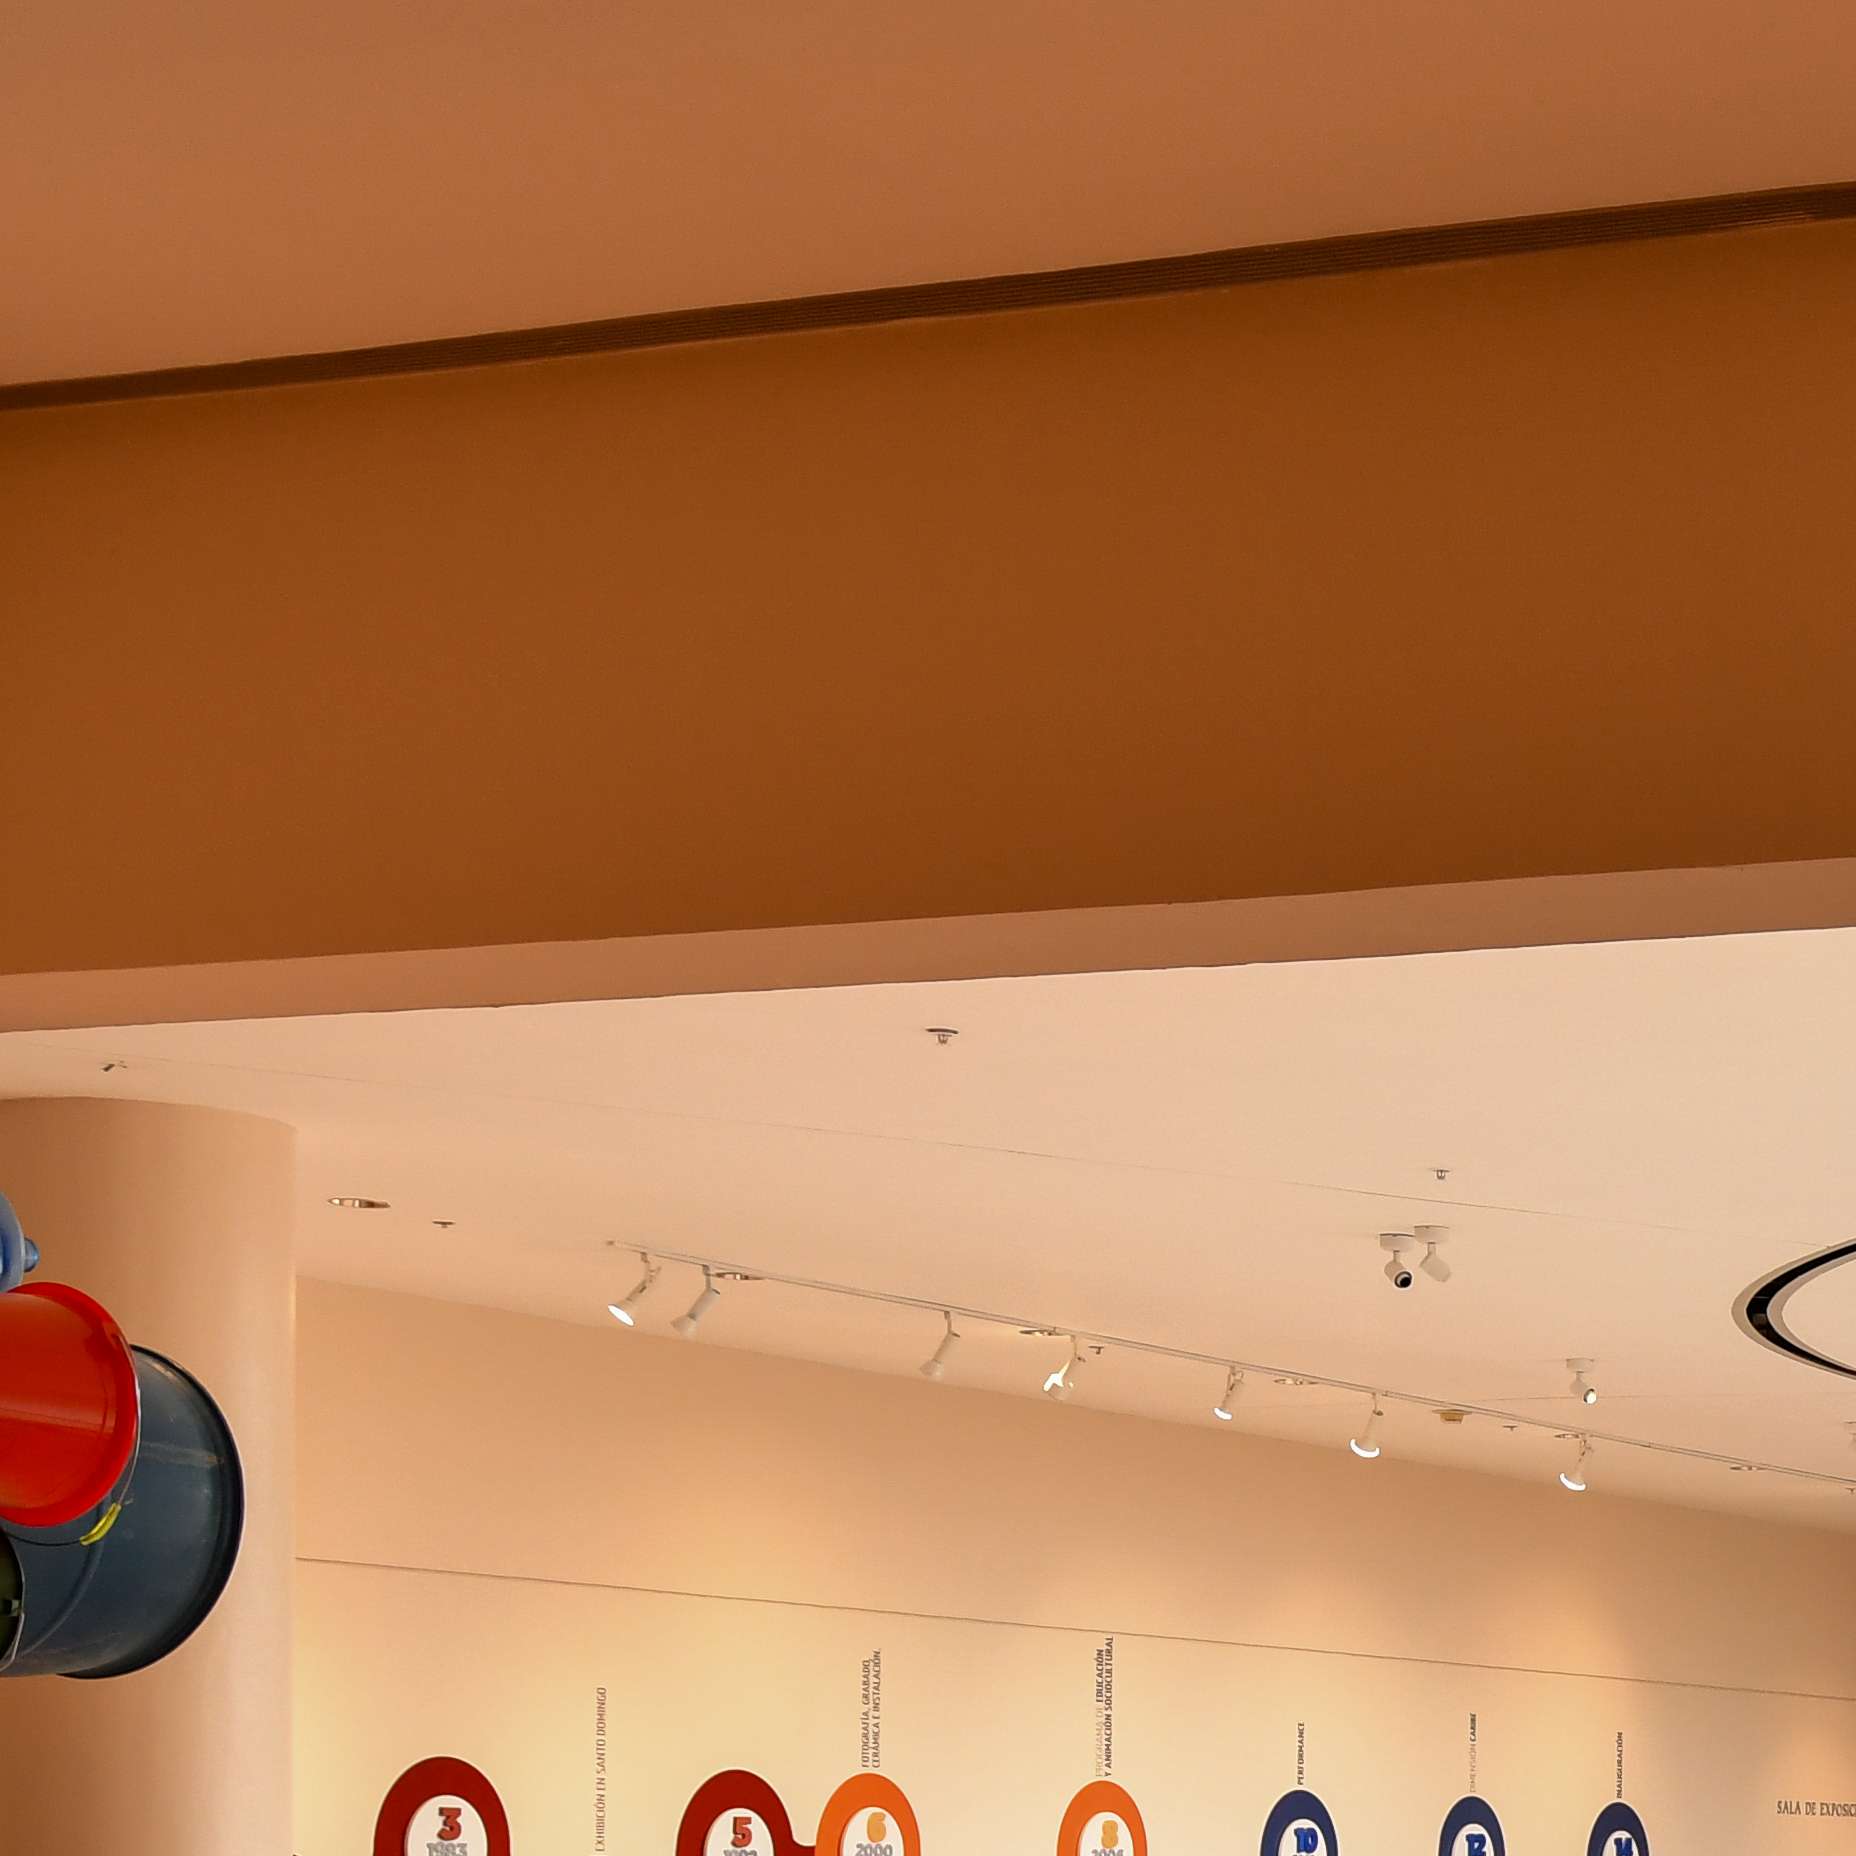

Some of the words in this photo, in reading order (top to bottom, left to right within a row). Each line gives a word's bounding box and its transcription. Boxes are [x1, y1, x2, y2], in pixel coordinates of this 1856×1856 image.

[1777, 1800, 1801, 1816] SALA
[1805, 1801, 1817, 1816] DE
[437, 1807, 462, 1841] 3
[731, 1816, 752, 1848] 5
[867, 1812, 886, 1843] 6
[1101, 1820, 1119, 1849] 8
[1293, 1827, 1319, 1854] 10
